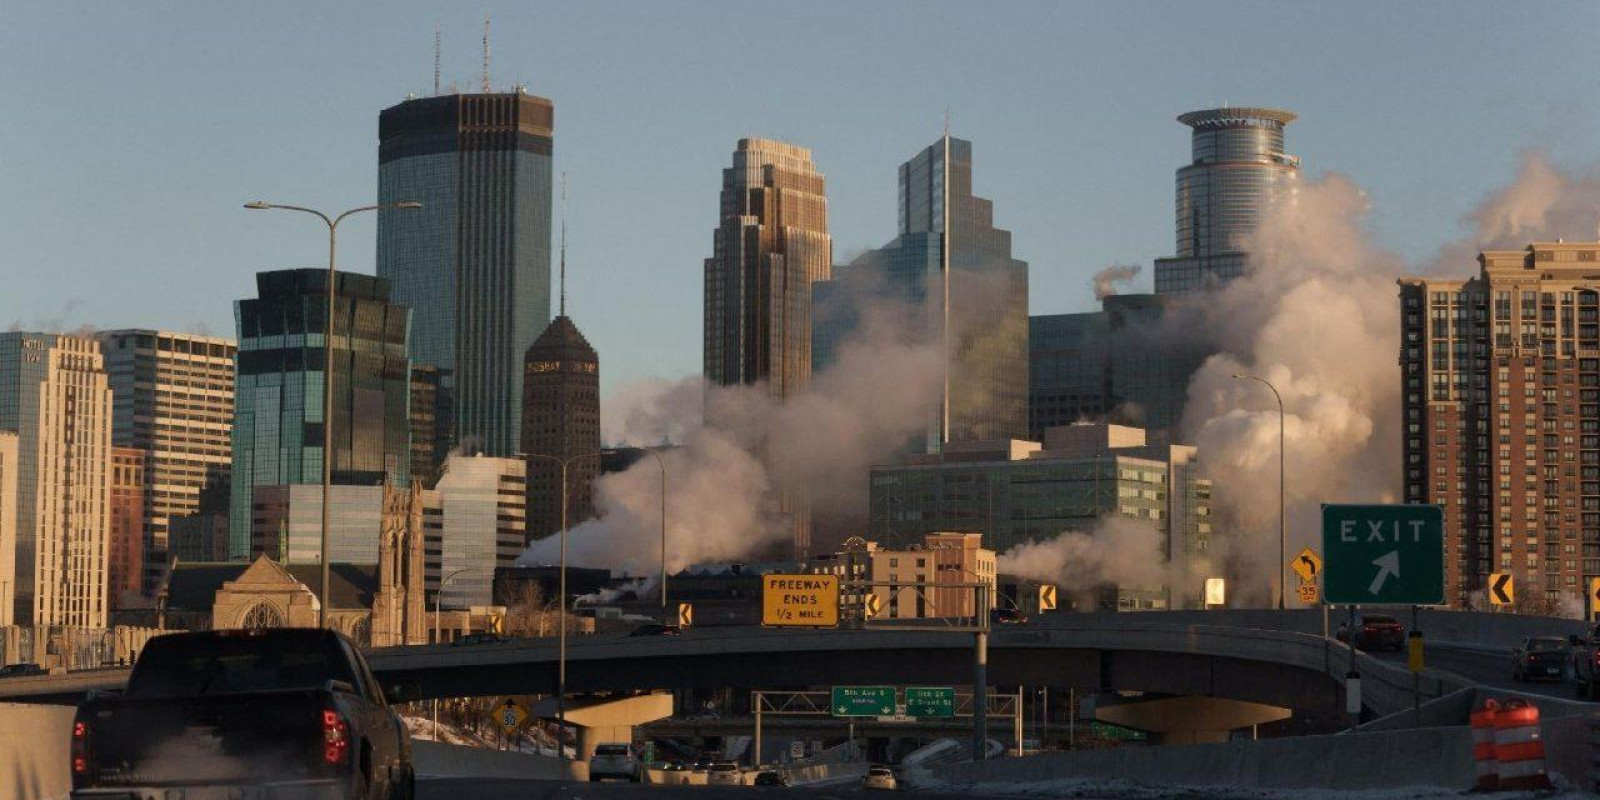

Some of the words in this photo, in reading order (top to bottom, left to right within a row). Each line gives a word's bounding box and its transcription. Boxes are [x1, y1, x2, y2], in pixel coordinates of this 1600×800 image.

[1341, 520, 1425, 541] EXIT
[770, 580, 830, 591] FREEWAY
[1302, 587, 1315, 595] 35
[784, 594, 817, 604] ENDS
[777, 608, 792, 619] 1/2
[799, 610, 824, 618] MILE
[504, 715, 516, 725] 30
